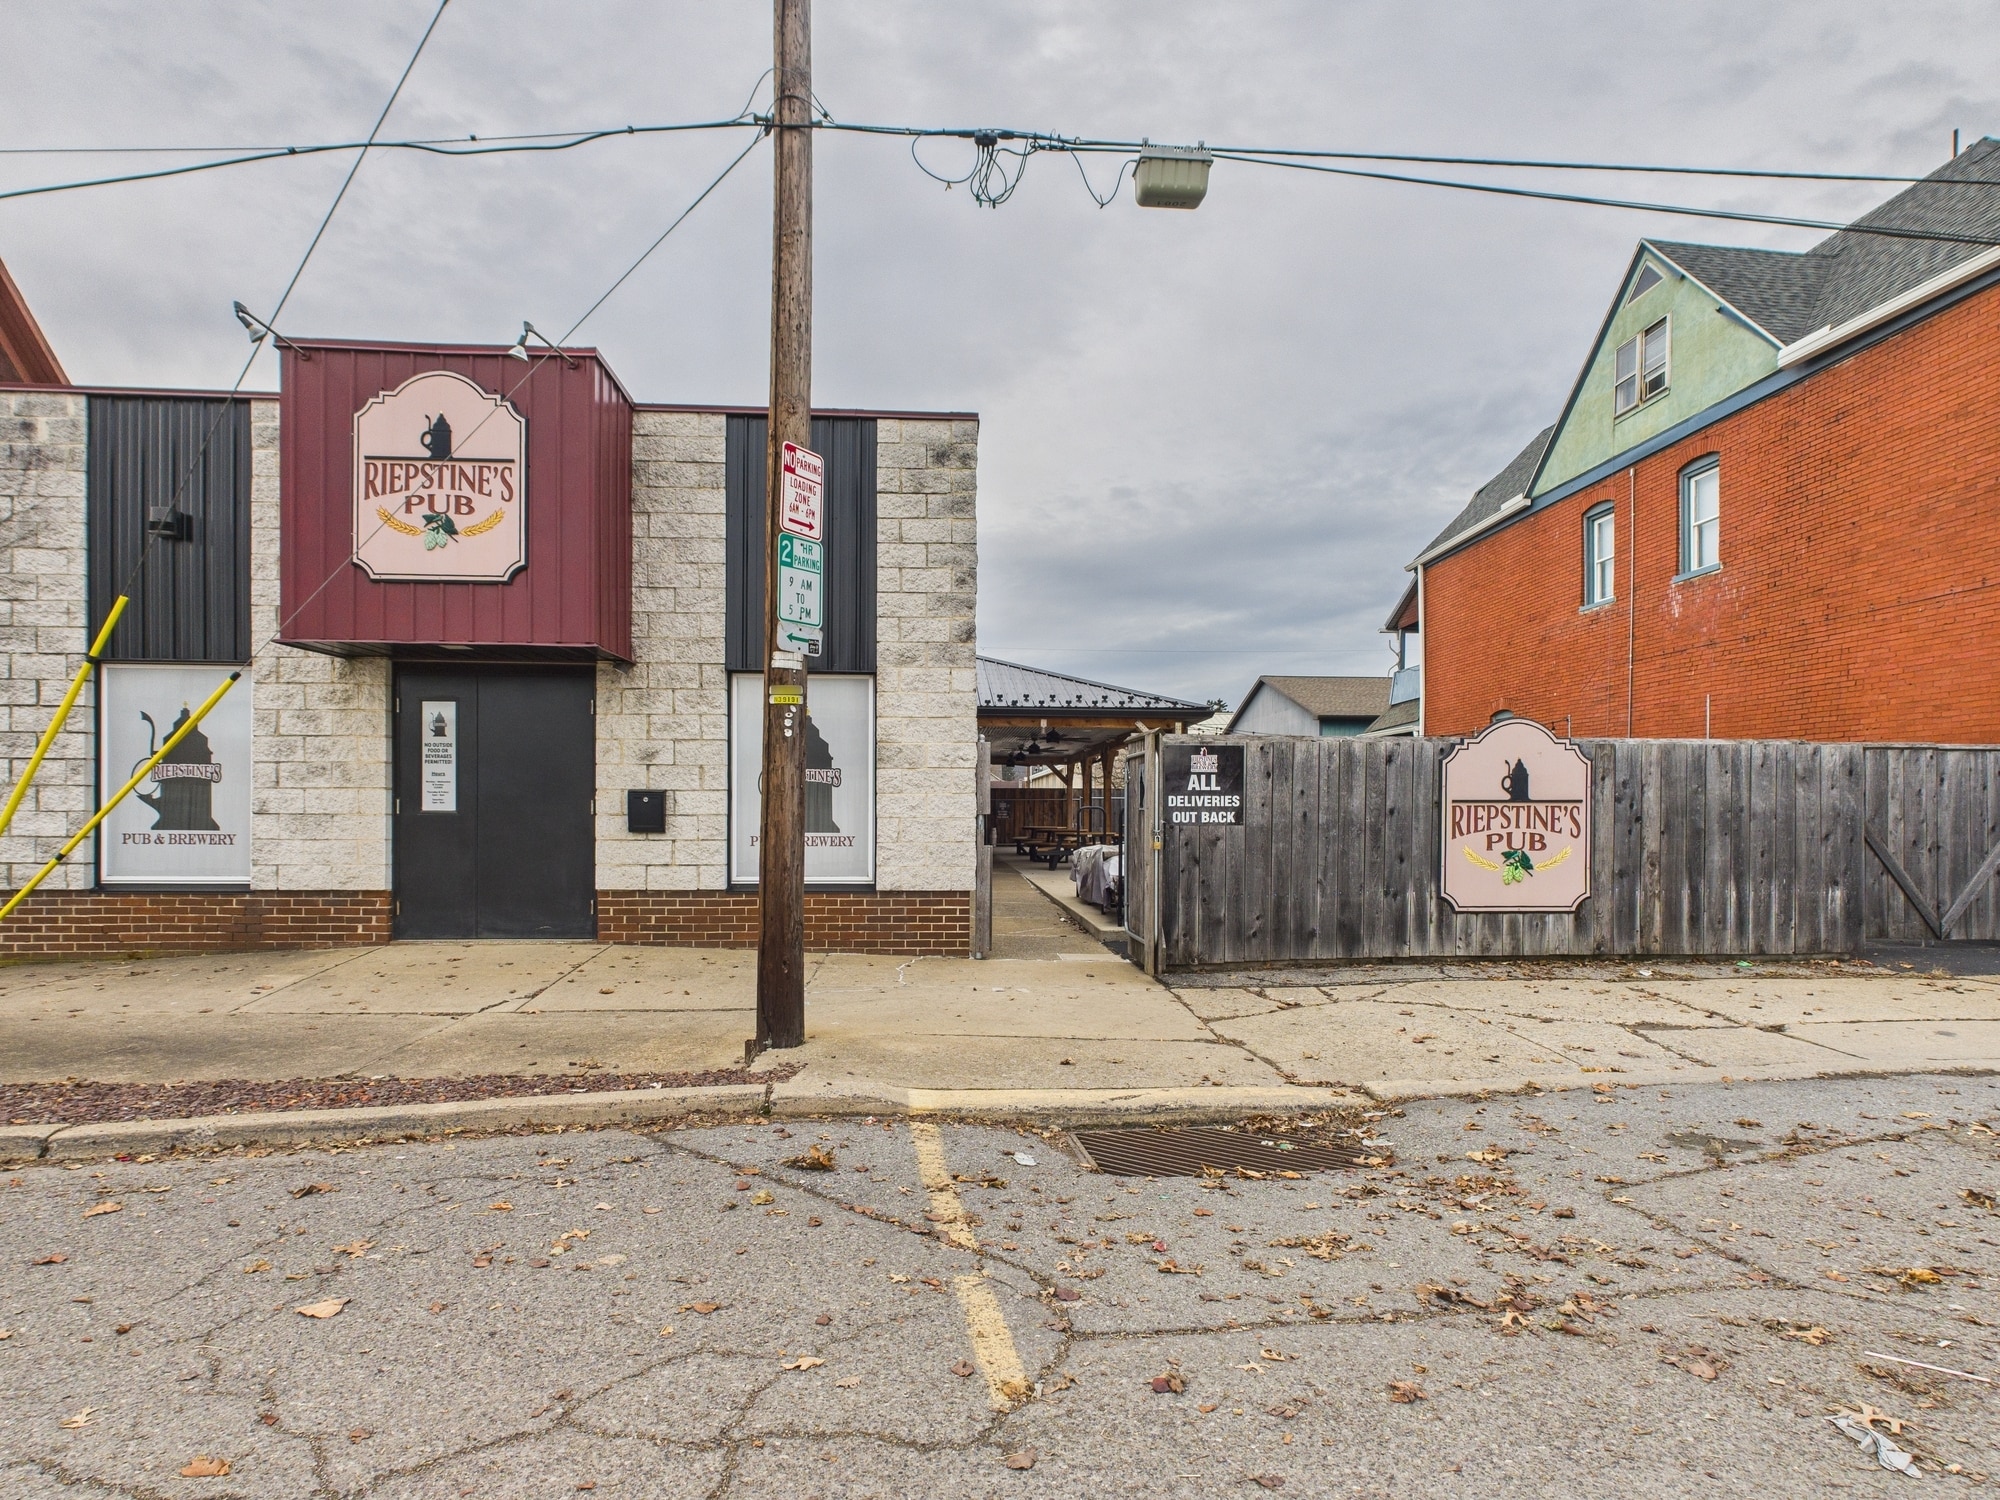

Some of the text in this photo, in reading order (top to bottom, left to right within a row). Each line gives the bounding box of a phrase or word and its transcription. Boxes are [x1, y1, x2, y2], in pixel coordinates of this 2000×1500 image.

[785, 449, 821, 477] NO PARKING
[364, 462, 514, 502] RIEPSTINE'S
[790, 476, 817, 496] LOADING
[404, 494, 475, 515] PUB
[794, 491, 811, 507] ZONE
[789, 502, 800, 515] 6AM
[805, 508, 816, 521] 6PM
[781, 540, 792, 563] 2
[802, 543, 813, 556] HR
[793, 555, 820, 571] PARKING
[789, 576, 812, 591] 9 AM
[795, 592, 805, 605] TO
[789, 605, 811, 619] 5 PM
[152, 763, 222, 782] RIEPSTINE'S
[1187, 774, 1221, 791] ALL
[1168, 795, 1240, 807] DELIVERIES
[1172, 811, 1236, 823] OUT BACK
[1451, 804, 1581, 840] RIEPSTINE'S
[122, 833, 236, 845] PUB & BREWERY
[804, 835, 855, 846] REWERY
[1486, 832, 1547, 852] PUB
